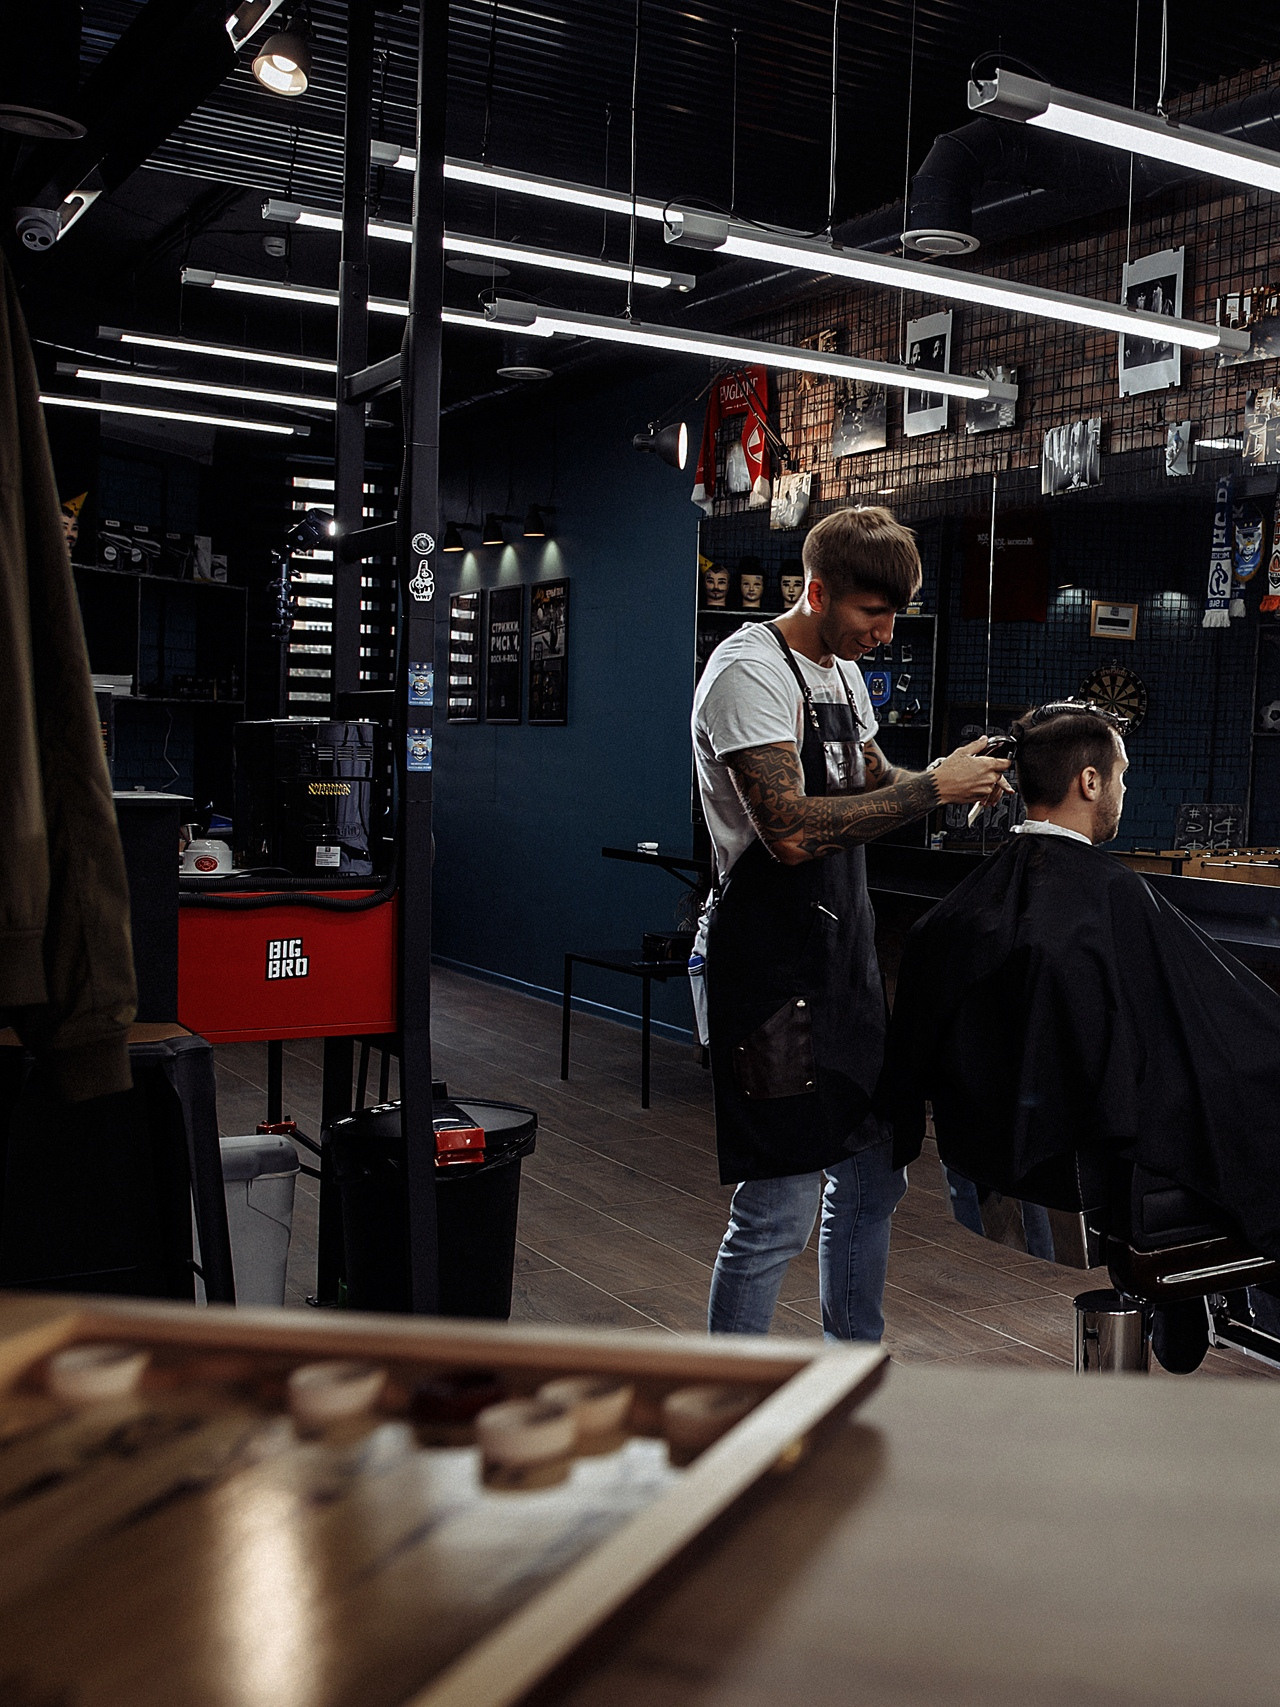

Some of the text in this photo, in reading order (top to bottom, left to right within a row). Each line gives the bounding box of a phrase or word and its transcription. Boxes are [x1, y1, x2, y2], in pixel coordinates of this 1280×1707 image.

[311, 784, 348, 794] WARNING
[268, 938, 302, 960] BIG
[268, 958, 308, 979] BRO
